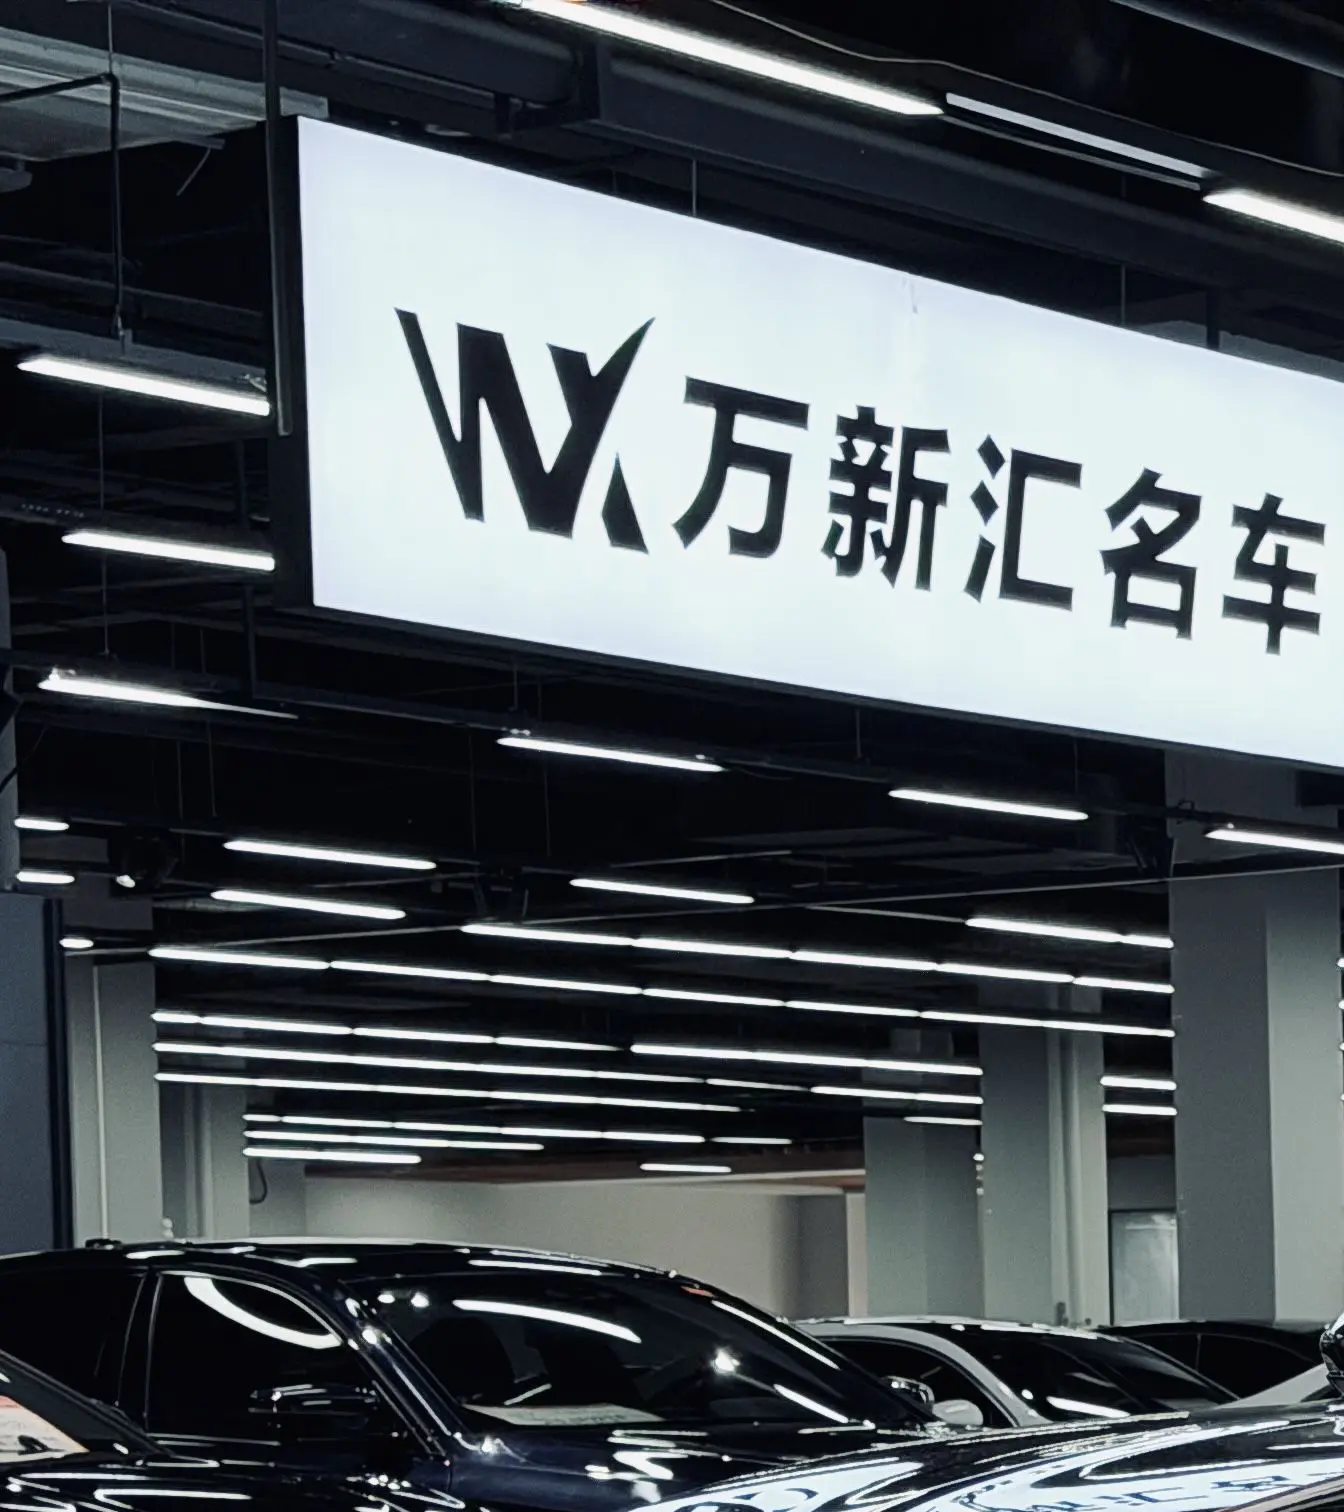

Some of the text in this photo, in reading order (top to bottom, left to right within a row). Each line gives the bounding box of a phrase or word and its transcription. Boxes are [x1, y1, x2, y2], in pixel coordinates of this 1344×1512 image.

[671, 375, 1327, 654] 万新汇名车
